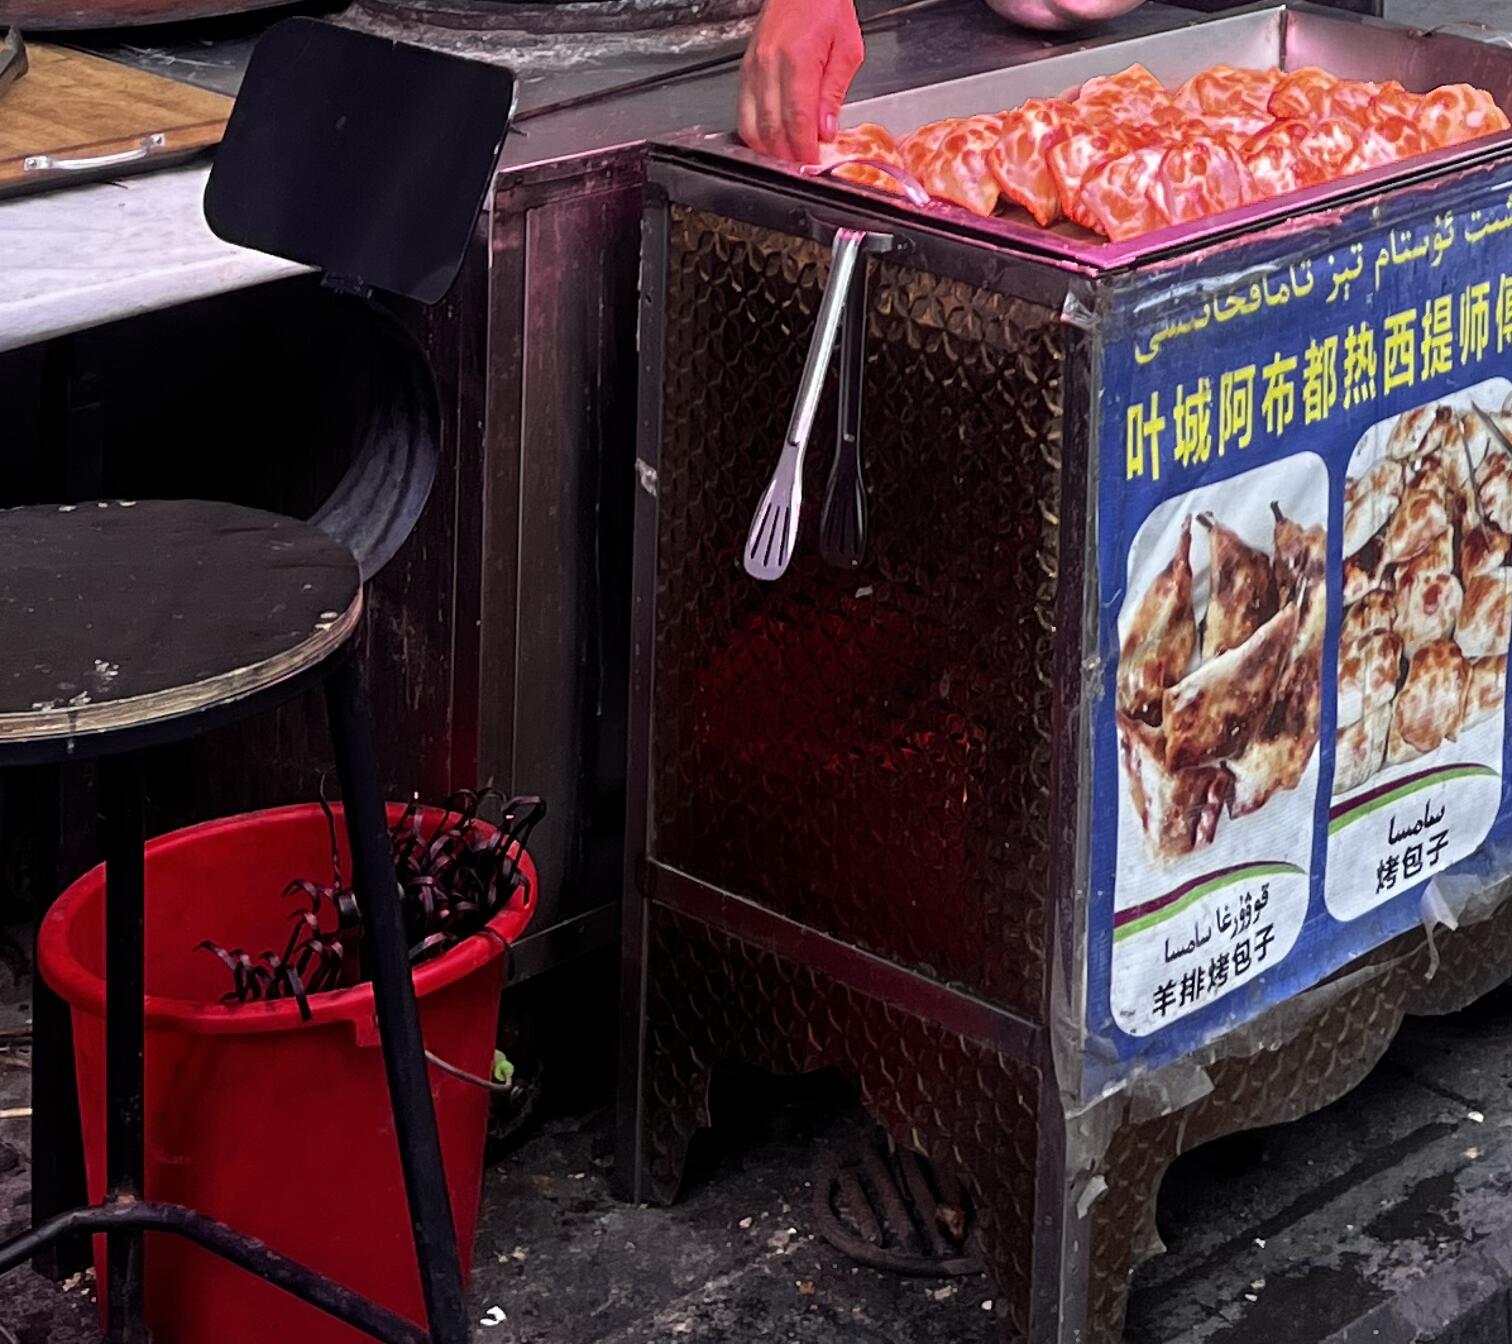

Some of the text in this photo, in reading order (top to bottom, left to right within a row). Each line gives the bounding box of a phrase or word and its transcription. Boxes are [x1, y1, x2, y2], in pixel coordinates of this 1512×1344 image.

[1376, 830, 1449, 894] 烤包子
[1152, 923, 1275, 1017] 羊排烤包子
